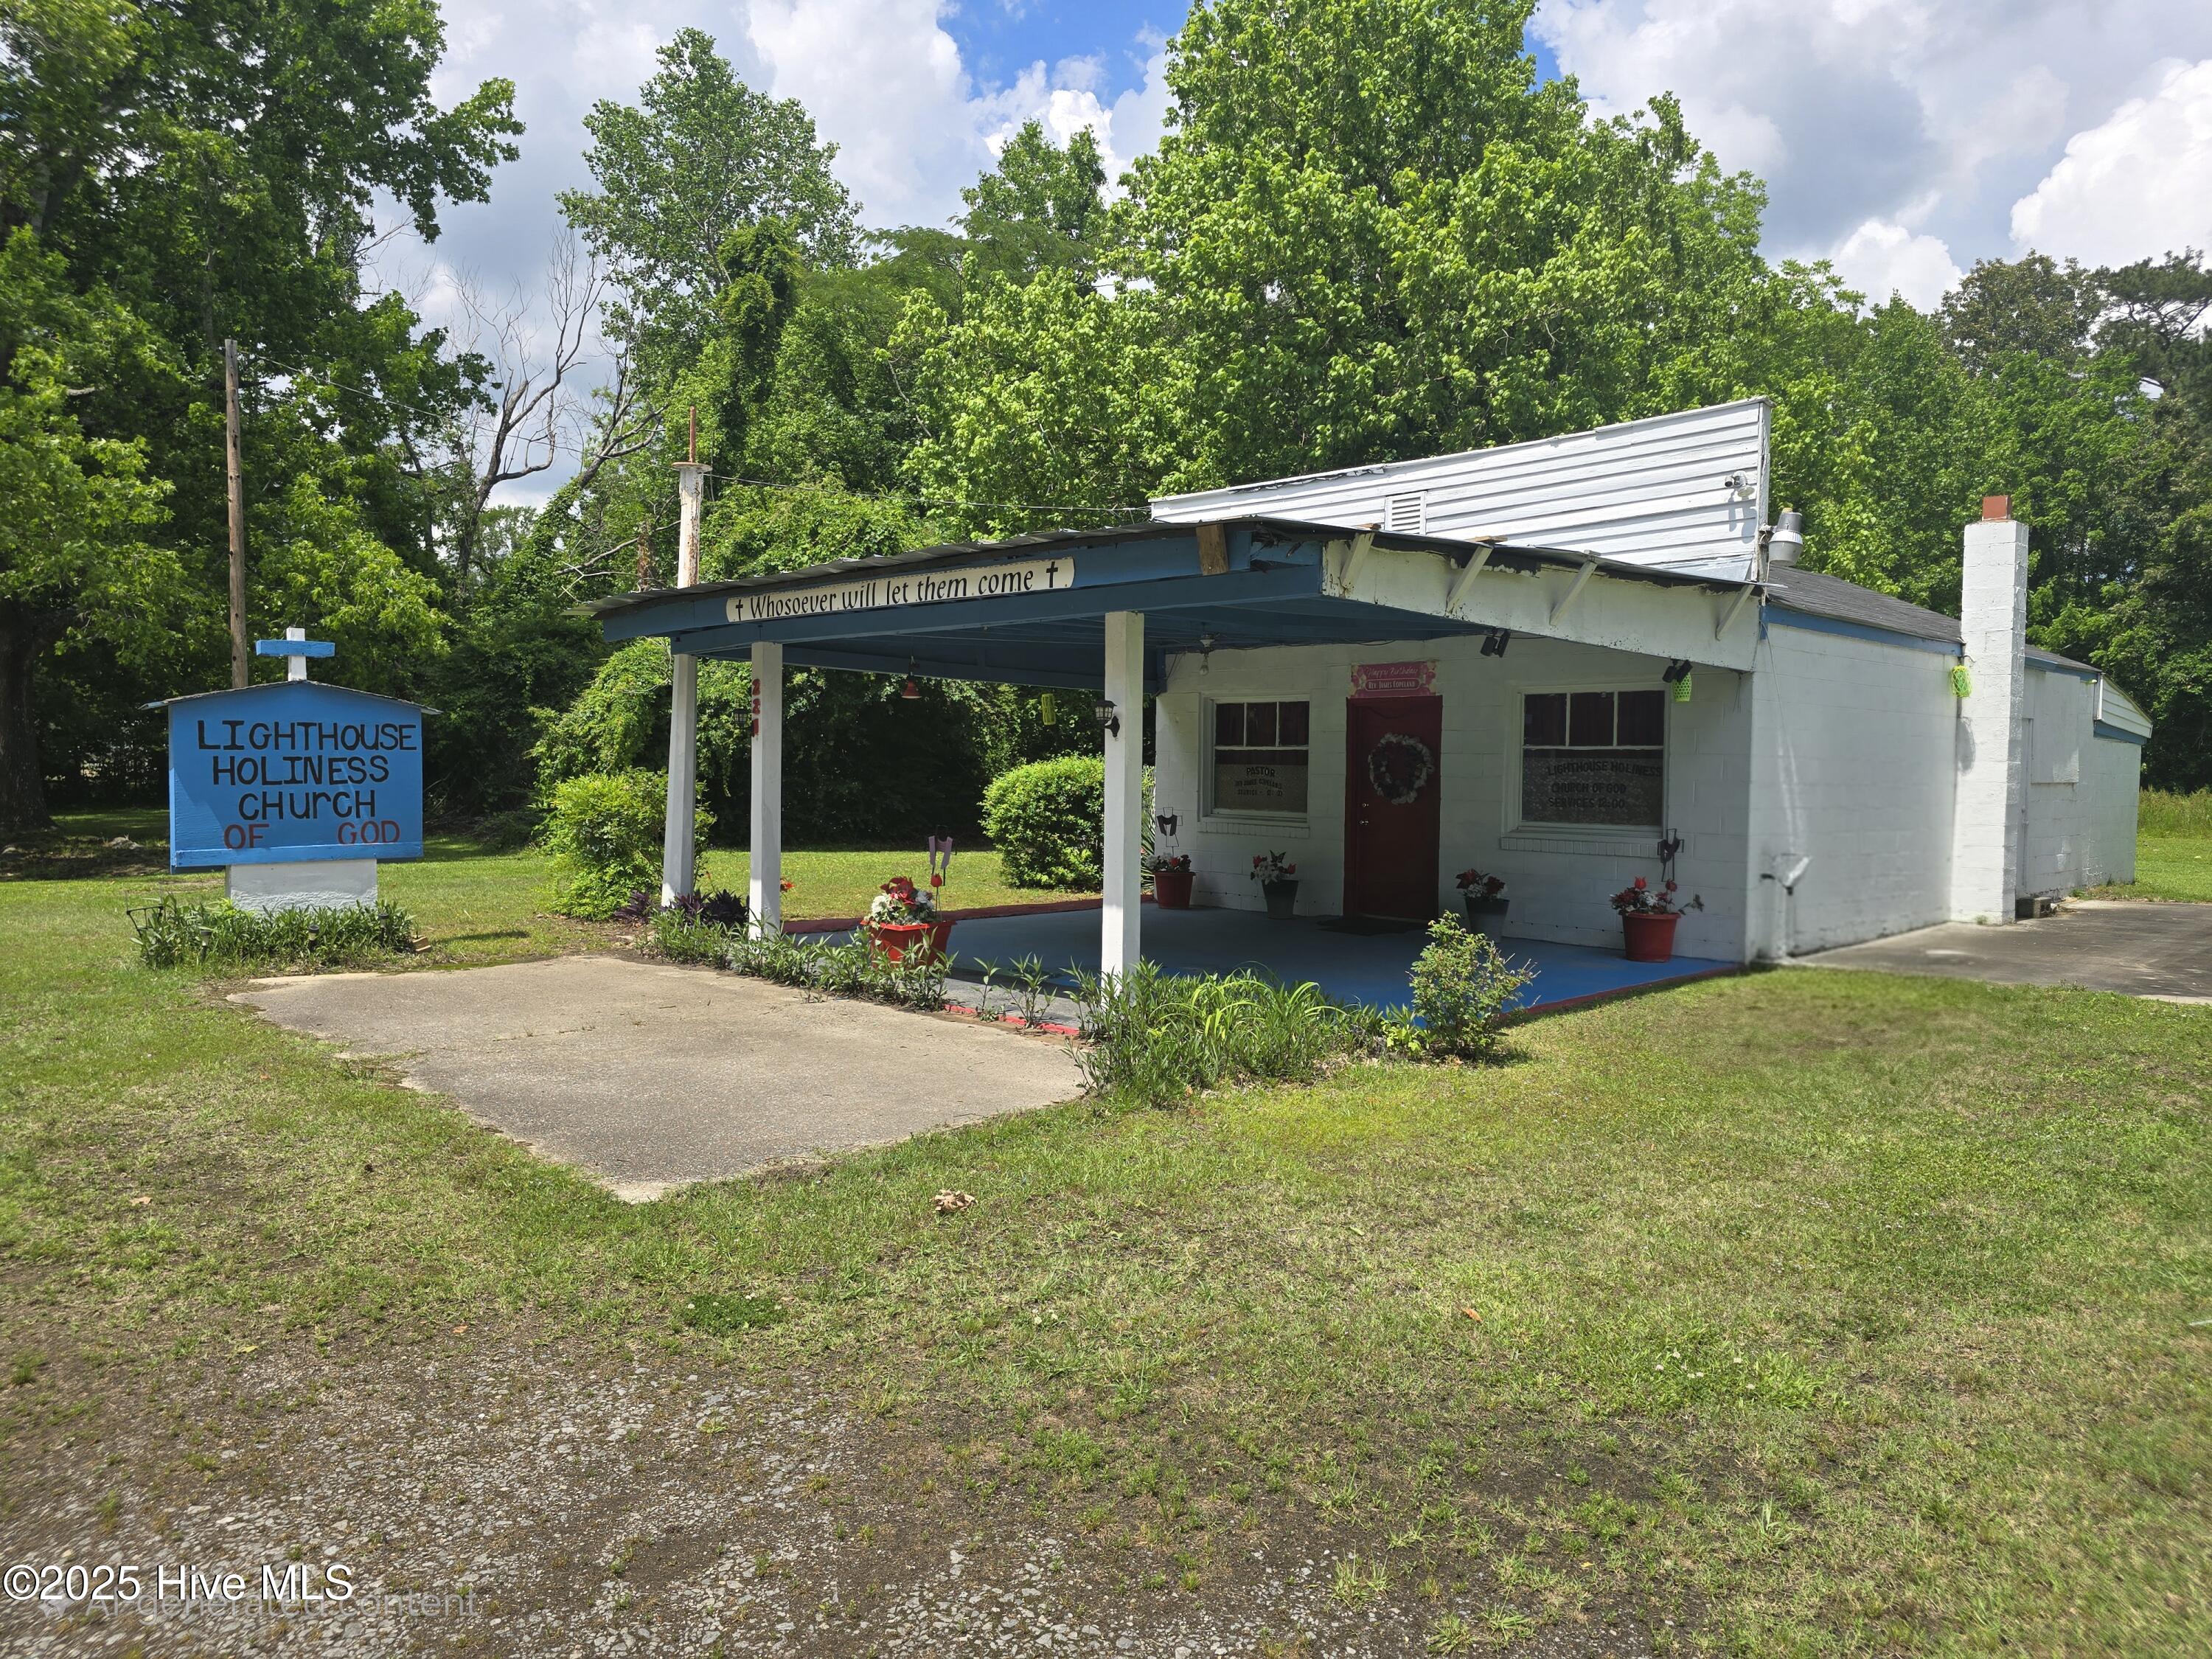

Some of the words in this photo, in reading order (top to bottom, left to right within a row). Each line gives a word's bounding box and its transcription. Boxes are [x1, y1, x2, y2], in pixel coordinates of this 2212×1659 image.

[751, 593, 837, 619] Whosoever
[842, 582, 877, 609] will
[887, 580, 909, 605] let
[917, 576, 967, 602] them
[978, 570, 1034, 595] come
[197, 720, 417, 751] LIGHTHOUSE
[212, 754, 389, 785] HOLINESS
[1246, 766, 1275, 777] PASTOR
[1548, 761, 1609, 776] LIGHTHOUSE
[1610, 762, 1663, 776] HOLINESS
[1551, 782, 1590, 793] CHURCH
[1592, 782, 1604, 793] OF
[1606, 782, 1627, 794] GOD
[1548, 797, 1595, 808] SERVICES
[223, 823, 270, 849] OF
[337, 820, 400, 845] GOD
